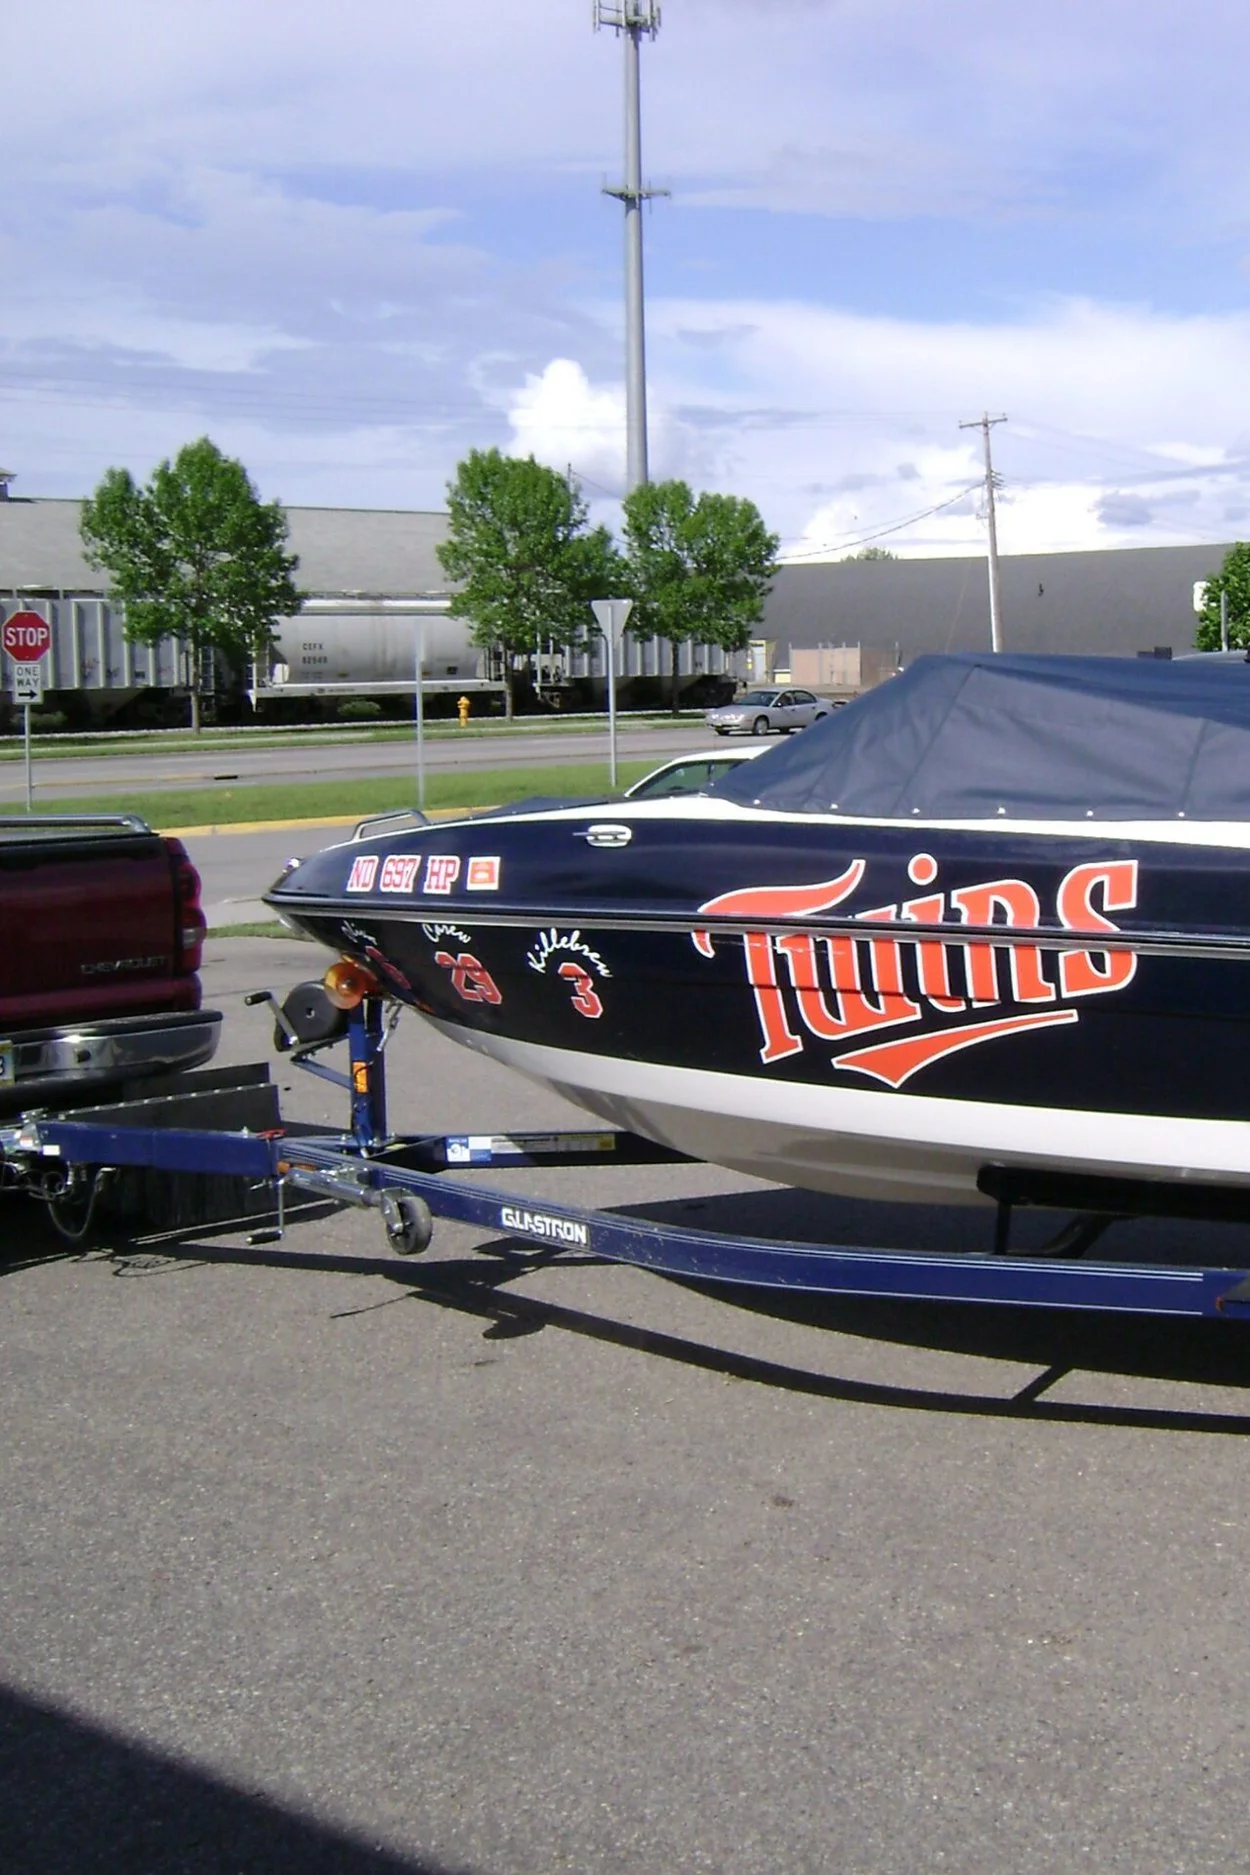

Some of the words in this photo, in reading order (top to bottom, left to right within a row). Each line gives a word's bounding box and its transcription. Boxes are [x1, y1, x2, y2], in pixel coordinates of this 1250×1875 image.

[5, 627, 48, 646] STOP
[16, 666, 40, 676] ONE
[16, 678, 40, 687] WAY
[346, 855, 379, 892] ND
[380, 855, 421, 893] 697
[423, 856, 460, 894] HP
[526, 927, 614, 978] Killebrew
[692, 853, 1138, 1064] Twins
[434, 951, 502, 1005] 29
[557, 962, 604, 1018] 3
[501, 1206, 588, 1244] GLASTRON
